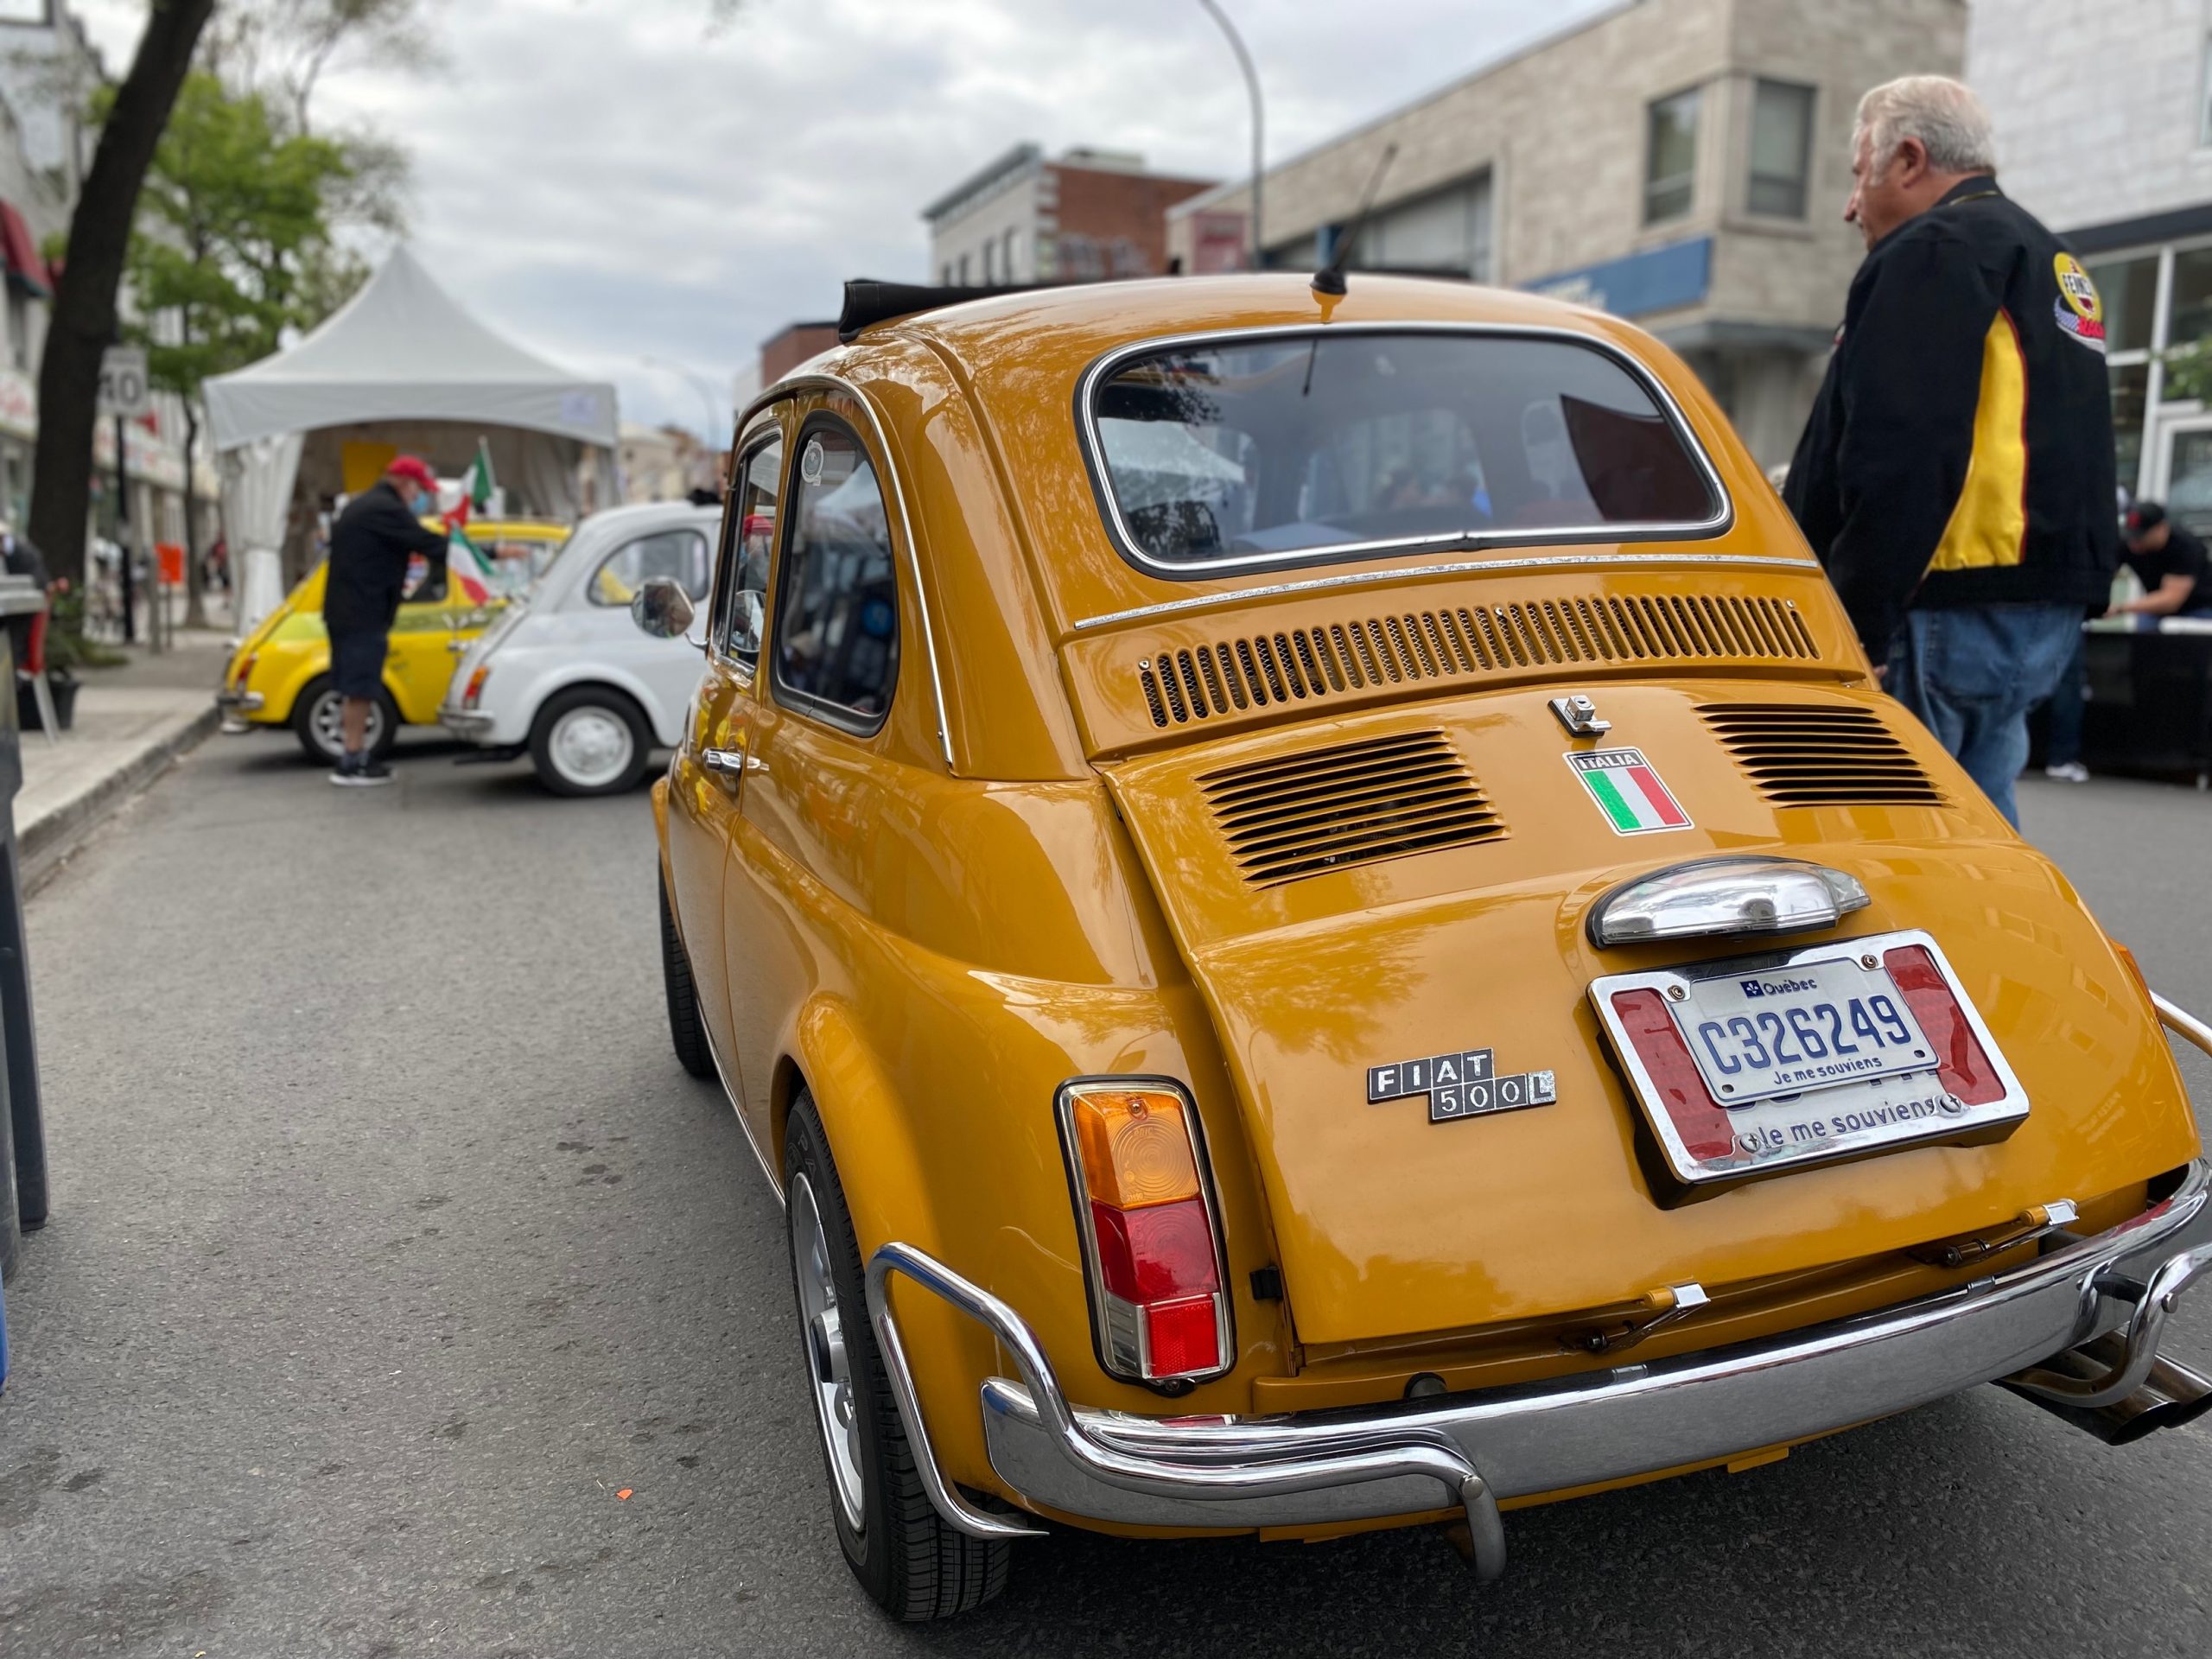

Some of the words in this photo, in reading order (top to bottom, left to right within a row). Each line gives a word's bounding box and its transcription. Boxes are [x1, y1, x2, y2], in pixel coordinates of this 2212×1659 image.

[1579, 753, 1640, 770] ITALIA
[1764, 979, 1817, 995] Québec
[1698, 995, 1911, 1075] C326249
[1378, 1053, 1488, 1093] FIAT
[1774, 1071, 1792, 1085] Je
[1793, 1068, 1816, 1082] me
[1815, 1058, 1883, 1077] souviens
[1440, 1075, 1553, 1112] 500L
[1790, 1121, 1827, 1141] me
[1831, 1098, 1936, 1134] souviens
